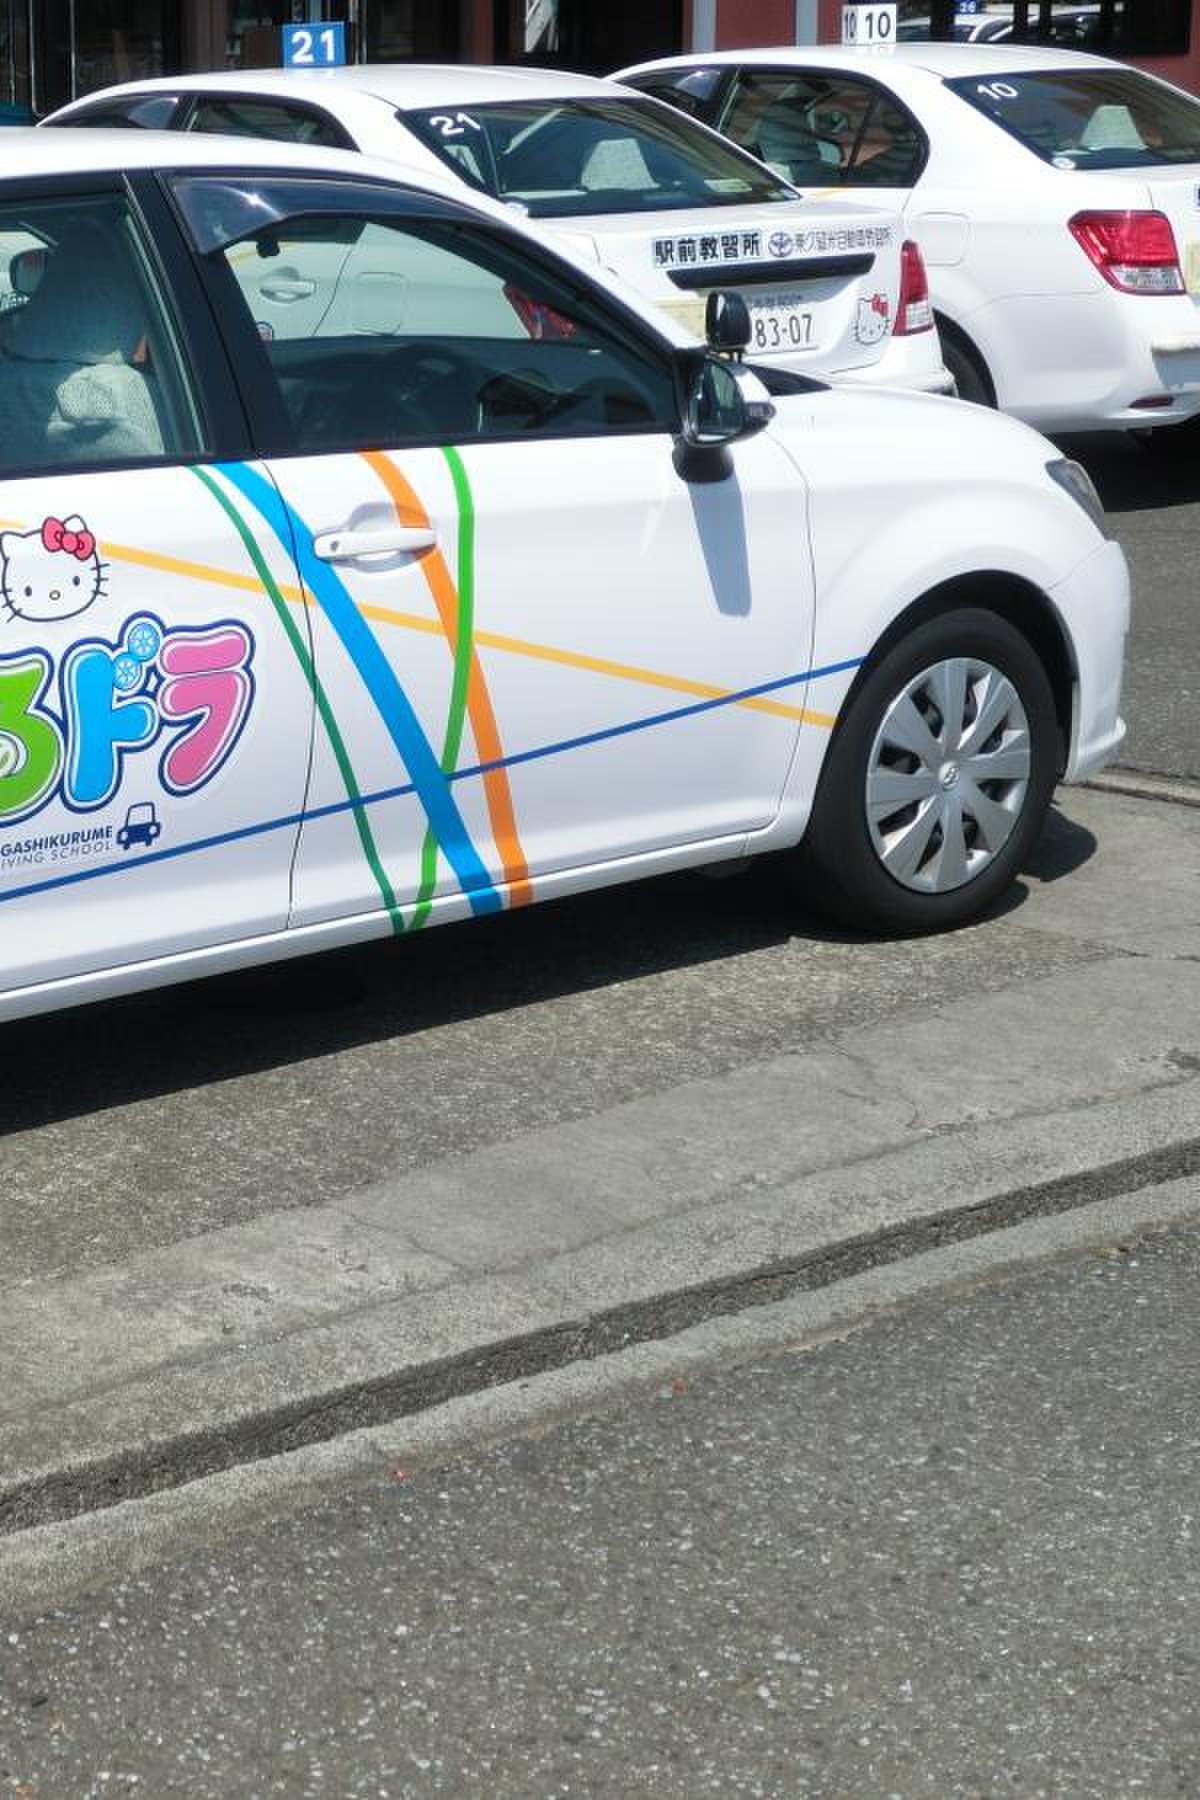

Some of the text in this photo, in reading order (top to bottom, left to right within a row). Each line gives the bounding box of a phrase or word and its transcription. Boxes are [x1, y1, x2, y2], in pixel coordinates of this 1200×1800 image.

[865, 11, 891, 39] 10
[291, 30, 335, 63] 21
[977, 81, 1019, 99] 10
[429, 111, 481, 137] 21
[655, 232, 761, 264] 駅前教習所
[755, 314, 812, 348] 83-07
[50, 840, 113, 863] SCHOOL
